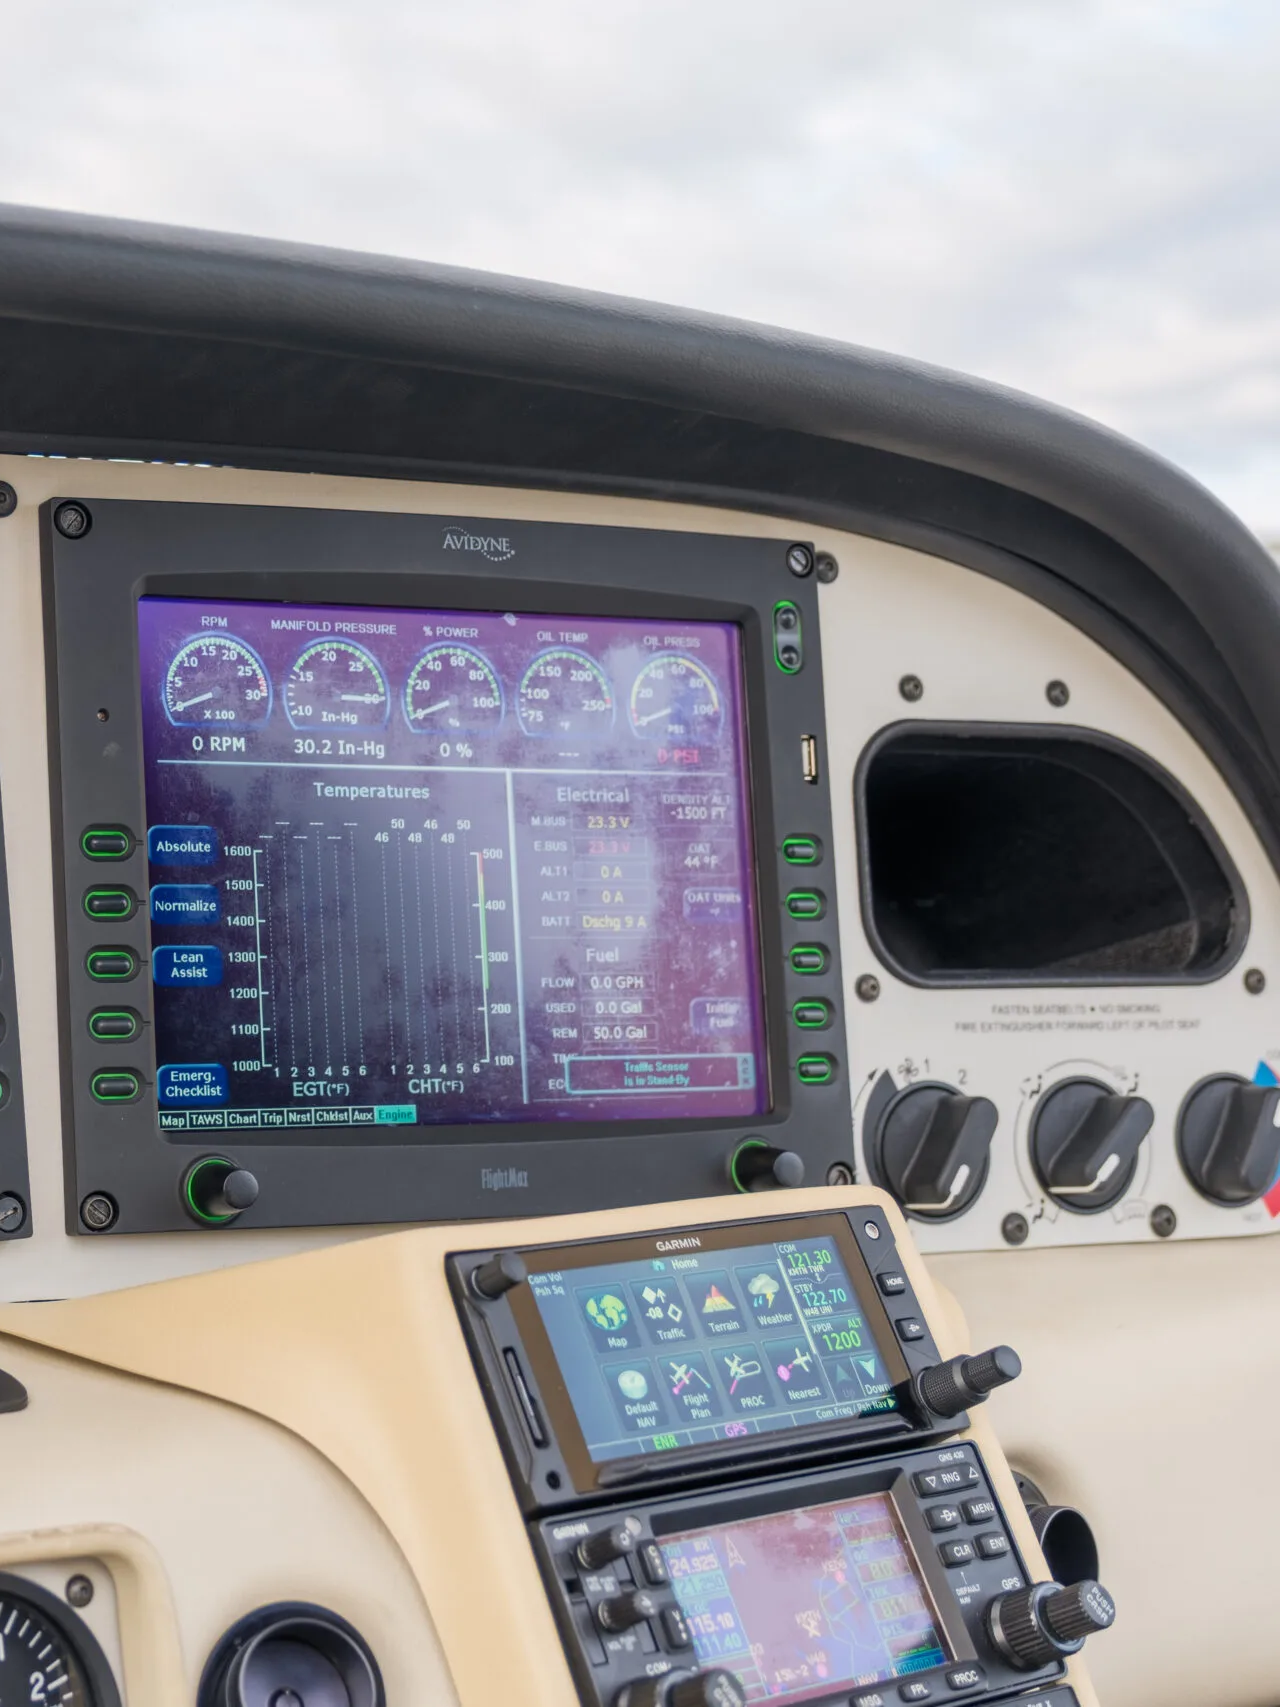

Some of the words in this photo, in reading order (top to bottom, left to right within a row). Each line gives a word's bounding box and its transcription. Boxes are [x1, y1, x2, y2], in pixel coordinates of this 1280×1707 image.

[442, 533, 511, 552] AVIDYNE
[201, 616, 228, 628] RPM
[271, 620, 332, 632] MANIFOLD
[334, 623, 398, 636] PRESSURE
[436, 628, 478, 639] POWER
[536, 631, 556, 642] OIL
[560, 632, 589, 643] TEMP
[192, 736, 203, 750] 0
[210, 737, 246, 752] RPM
[294, 739, 332, 755] 30.2
[338, 741, 385, 758] In-Hg
[313, 782, 430, 800] Temperatures
[557, 787, 629, 803] Electrical
[156, 841, 211, 853] Absolute
[224, 846, 252, 857] 1600
[224, 879, 253, 891] 1500
[154, 900, 217, 913] Normalize
[226, 915, 255, 927] 1400
[582, 915, 620, 931] Dschg
[637, 916, 646, 928] A
[173, 952, 204, 964] Lean
[228, 952, 256, 963] 1300
[586, 948, 619, 963] Fuel
[171, 966, 208, 979] Assist
[230, 987, 258, 999] 1200
[231, 1023, 259, 1035] 1100
[552, 1029, 577, 1038] REM
[593, 1026, 621, 1040] 50.0
[625, 1025, 647, 1039] Gal
[232, 1060, 261, 1072] 1000
[170, 1070, 216, 1084] Emerg.
[165, 1085, 222, 1098] Checklist
[161, 1115, 185, 1128] Map
[191, 1113, 223, 1126] TAWS
[229, 1112, 257, 1125] Chart
[262, 1111, 283, 1125] Trip
[289, 1110, 312, 1123] Nrst
[316, 1109, 348, 1122] Chklst
[353, 1109, 374, 1121] Aux
[378, 1107, 413, 1122] Engine
[481, 1167, 529, 1191] FlightMax
[655, 1237, 702, 1252] GARMIN
[671, 1257, 699, 1270] Home
[787, 1249, 832, 1268] 121.30
[886, 1276, 904, 1286] HOME
[802, 1288, 847, 1307] 122.70
[757, 1313, 793, 1326] Weather
[708, 1320, 740, 1334] Terrain
[657, 1327, 686, 1341] Traffic
[607, 1336, 628, 1348] Map
[822, 1330, 862, 1352] 1200
[787, 1387, 822, 1400] Nearest
[865, 1383, 890, 1396] Down
[682, 1393, 709, 1408] Flight
[740, 1395, 766, 1409] PROC
[625, 1401, 659, 1416] Default
[691, 1408, 711, 1420] Plan
[636, 1416, 656, 1428] NAV
[724, 1423, 748, 1437] GPS
[652, 1434, 679, 1450] ENR
[941, 1471, 961, 1483] RNG
[971, 1502, 995, 1515] MENU
[989, 1537, 1006, 1549] ENT
[953, 1546, 972, 1557] CLR
[1001, 1577, 1021, 1590] GPS
[1091, 1586, 1114, 1615] PUSH
[1086, 1593, 1109, 1622] CRSR
[954, 1670, 979, 1685] PROC
[29, 1671, 45, 1702] 2
[910, 1682, 928, 1696] FPL
